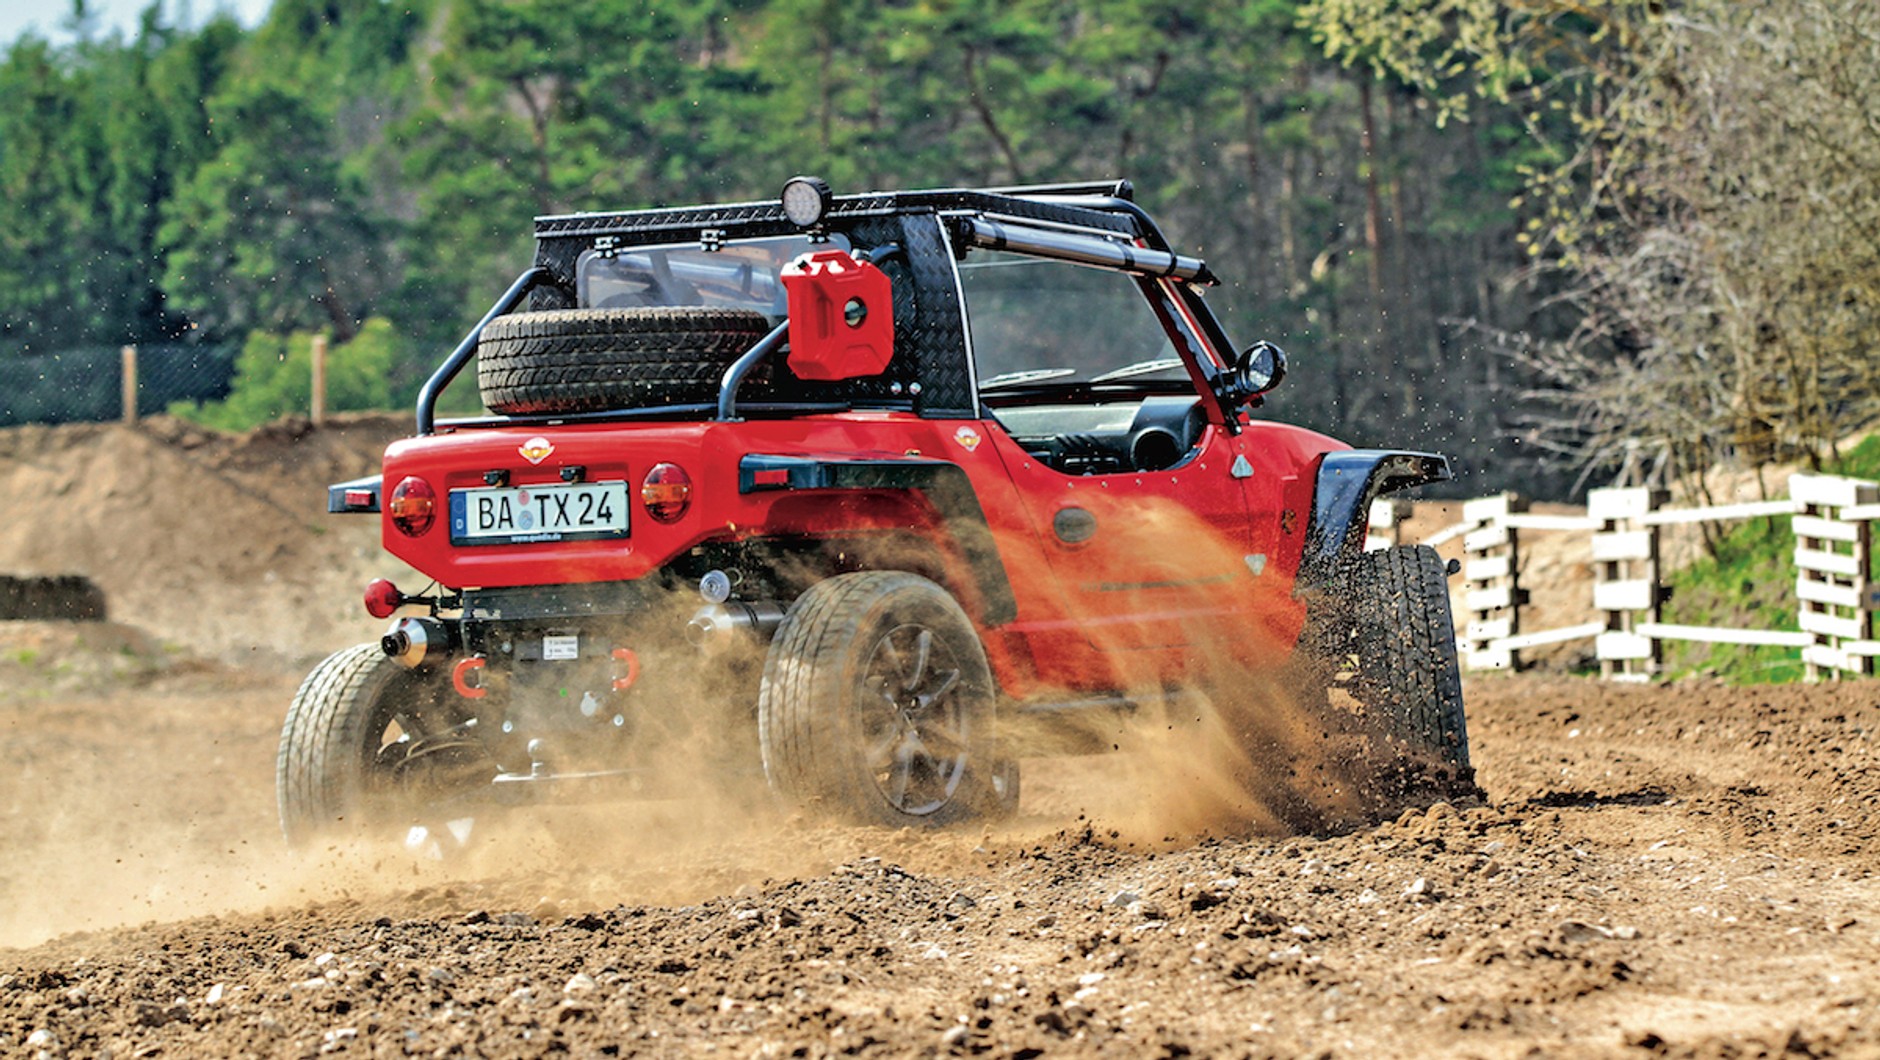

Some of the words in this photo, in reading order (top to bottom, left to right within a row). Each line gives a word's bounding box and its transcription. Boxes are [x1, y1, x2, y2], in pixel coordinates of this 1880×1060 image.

[478, 496, 514, 530] BA
[534, 493, 570, 527] TX
[577, 491, 613, 525] 24
